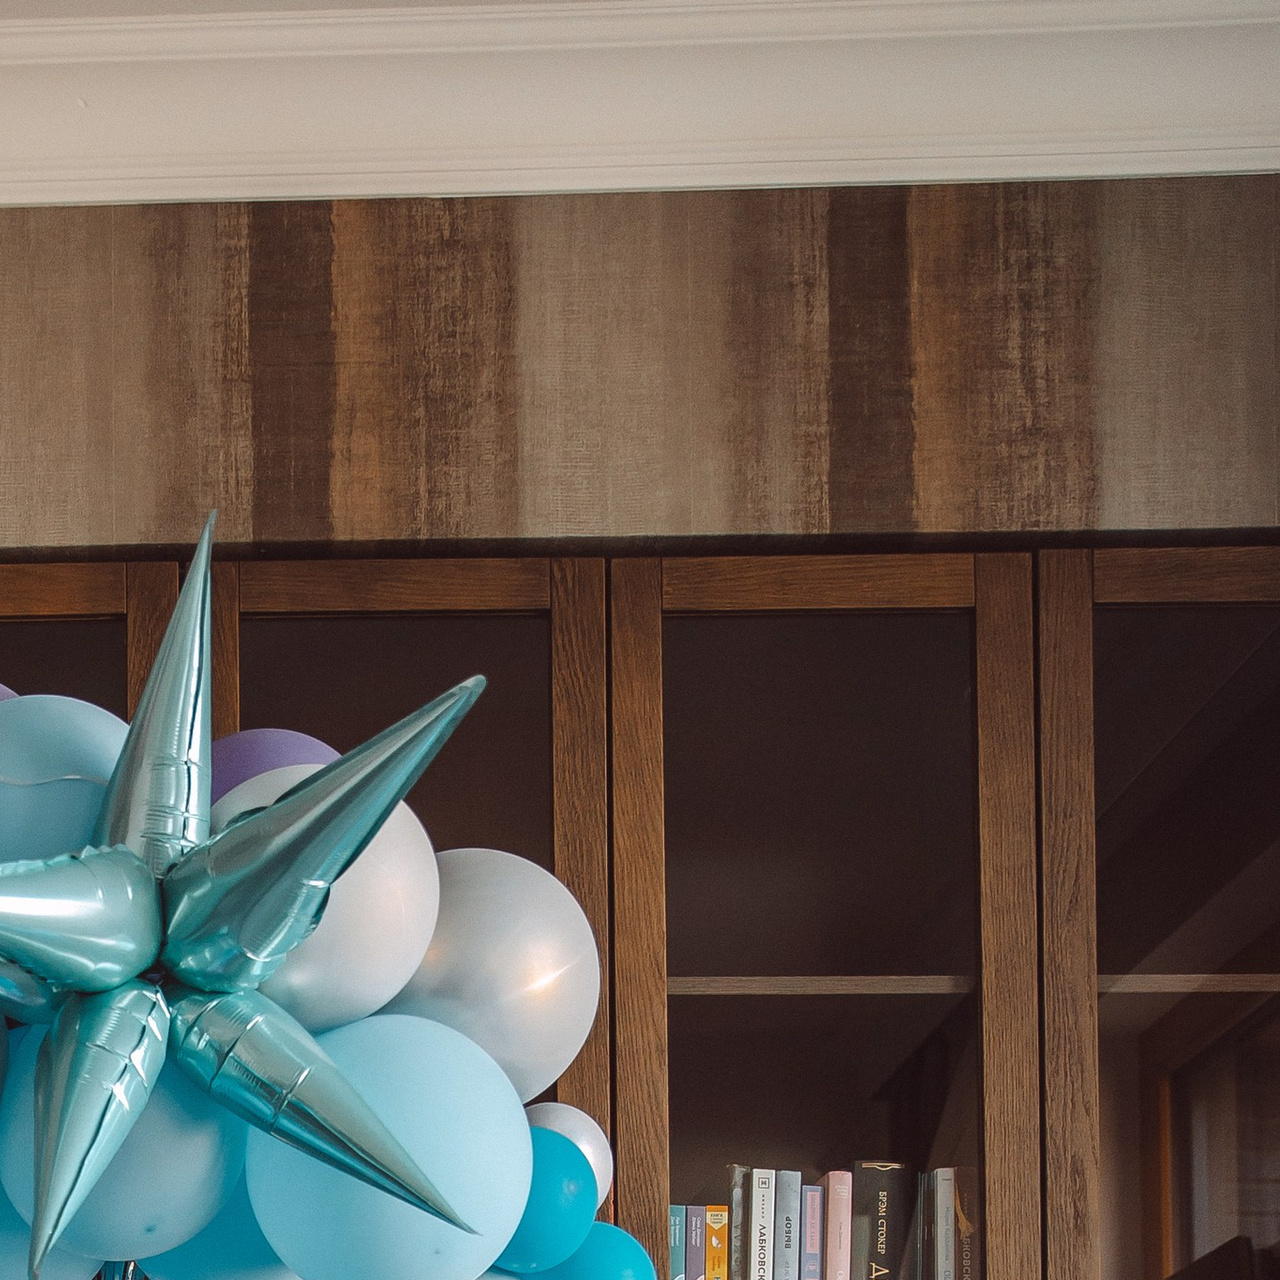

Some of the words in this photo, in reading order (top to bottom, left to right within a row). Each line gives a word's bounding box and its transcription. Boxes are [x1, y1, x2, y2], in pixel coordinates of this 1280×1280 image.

[877, 1190, 887, 1216] БРЭМ
[784, 1214, 793, 1249] ВЫБОР
[876, 1218, 886, 1255] СТОКЕР
